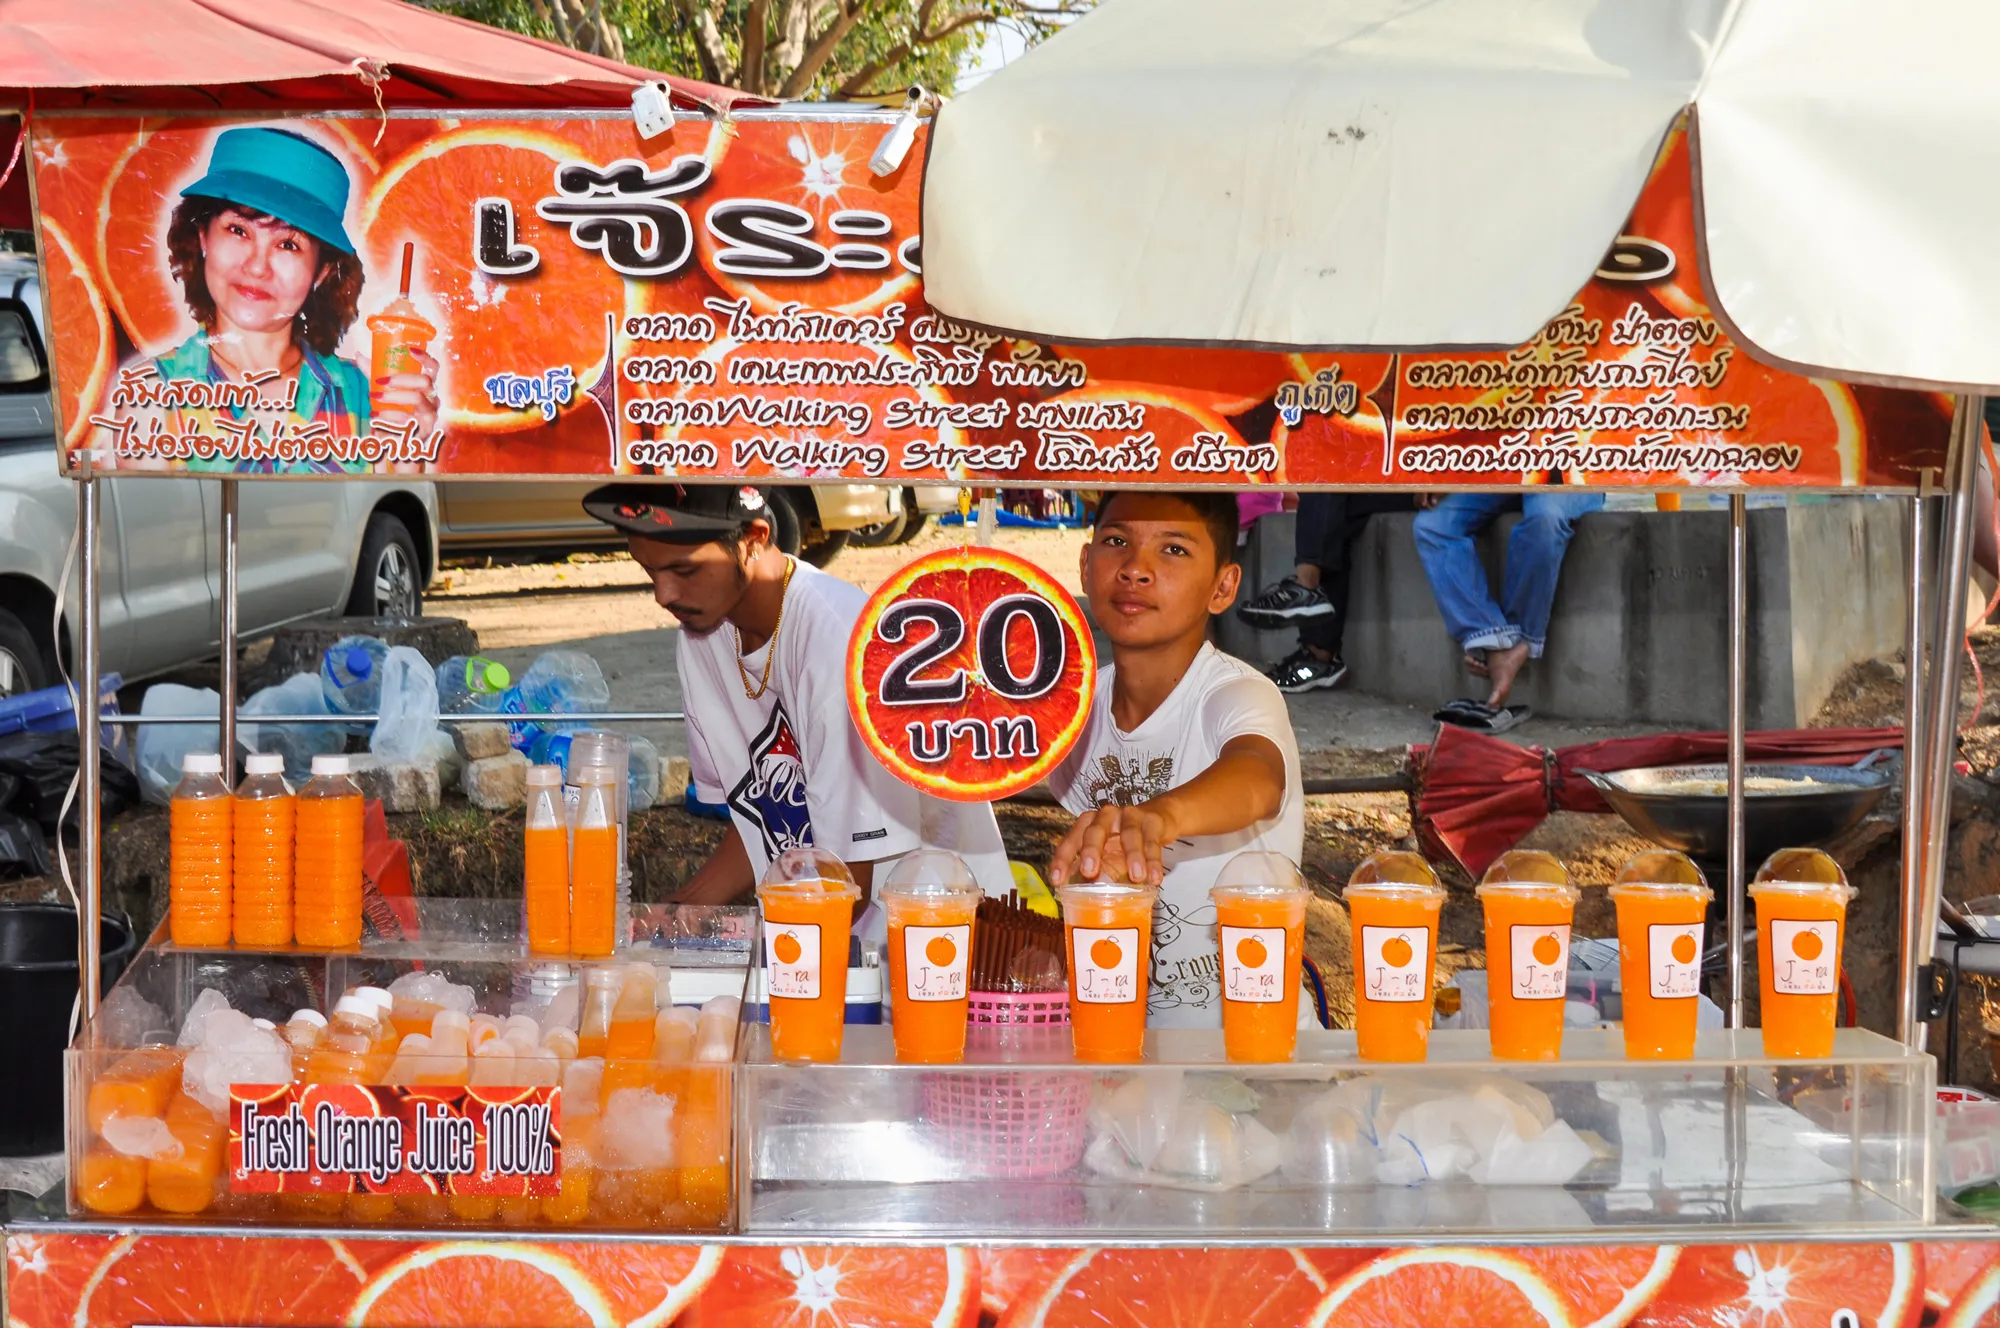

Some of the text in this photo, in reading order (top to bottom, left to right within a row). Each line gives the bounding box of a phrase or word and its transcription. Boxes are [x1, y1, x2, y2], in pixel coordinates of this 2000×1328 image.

[624, 312, 715, 341] ตลาด
[625, 356, 716, 386] ตลาด
[989, 345, 1087, 387] พัทยา
[483, 364, 576, 422] ชลบุรี
[884, 398, 1010, 428] Street
[1016, 398, 1144, 430] บางแสน
[1275, 364, 1357, 426] ภูเก็ต
[91, 415, 446, 463] ไม่อร่อยไม่ต้องเอาไป
[627, 439, 717, 469] ตลาด
[731, 437, 888, 476] Walking
[900, 440, 1026, 470] Street
[1170, 431, 1279, 472] ศรีราชา
[877, 593, 1066, 706] 20
[905, 715, 1040, 763] บาท
[240, 1099, 554, 1185] Fresh Orange Juice 100%
